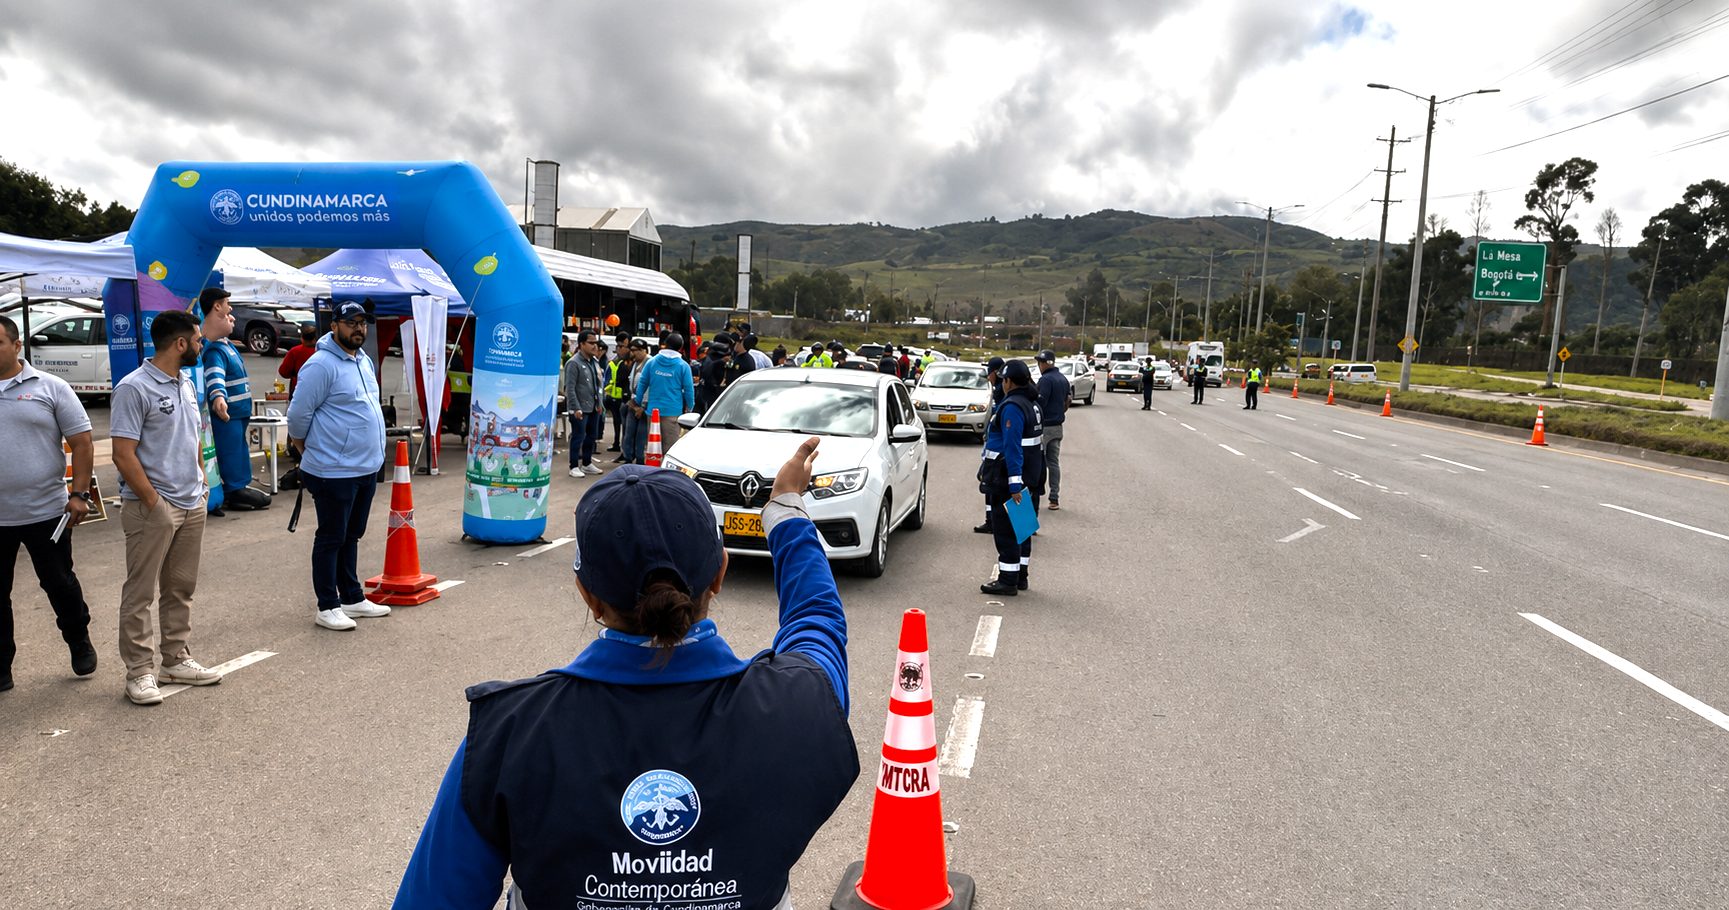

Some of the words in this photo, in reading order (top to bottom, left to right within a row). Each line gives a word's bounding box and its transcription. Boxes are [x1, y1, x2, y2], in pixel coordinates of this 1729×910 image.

[247, 193, 388, 209] CUNDINAMARCA
[249, 209, 294, 222] unidos
[298, 210, 359, 225] podemos
[362, 209, 390, 222] más
[1497, 250, 1521, 262] Mesa
[1481, 267, 1513, 281] Bogotá
[725, 516, 765, 533] JSS-28
[612, 848, 713, 875] Moviidad
[585, 874, 738, 903] Contemporánea
